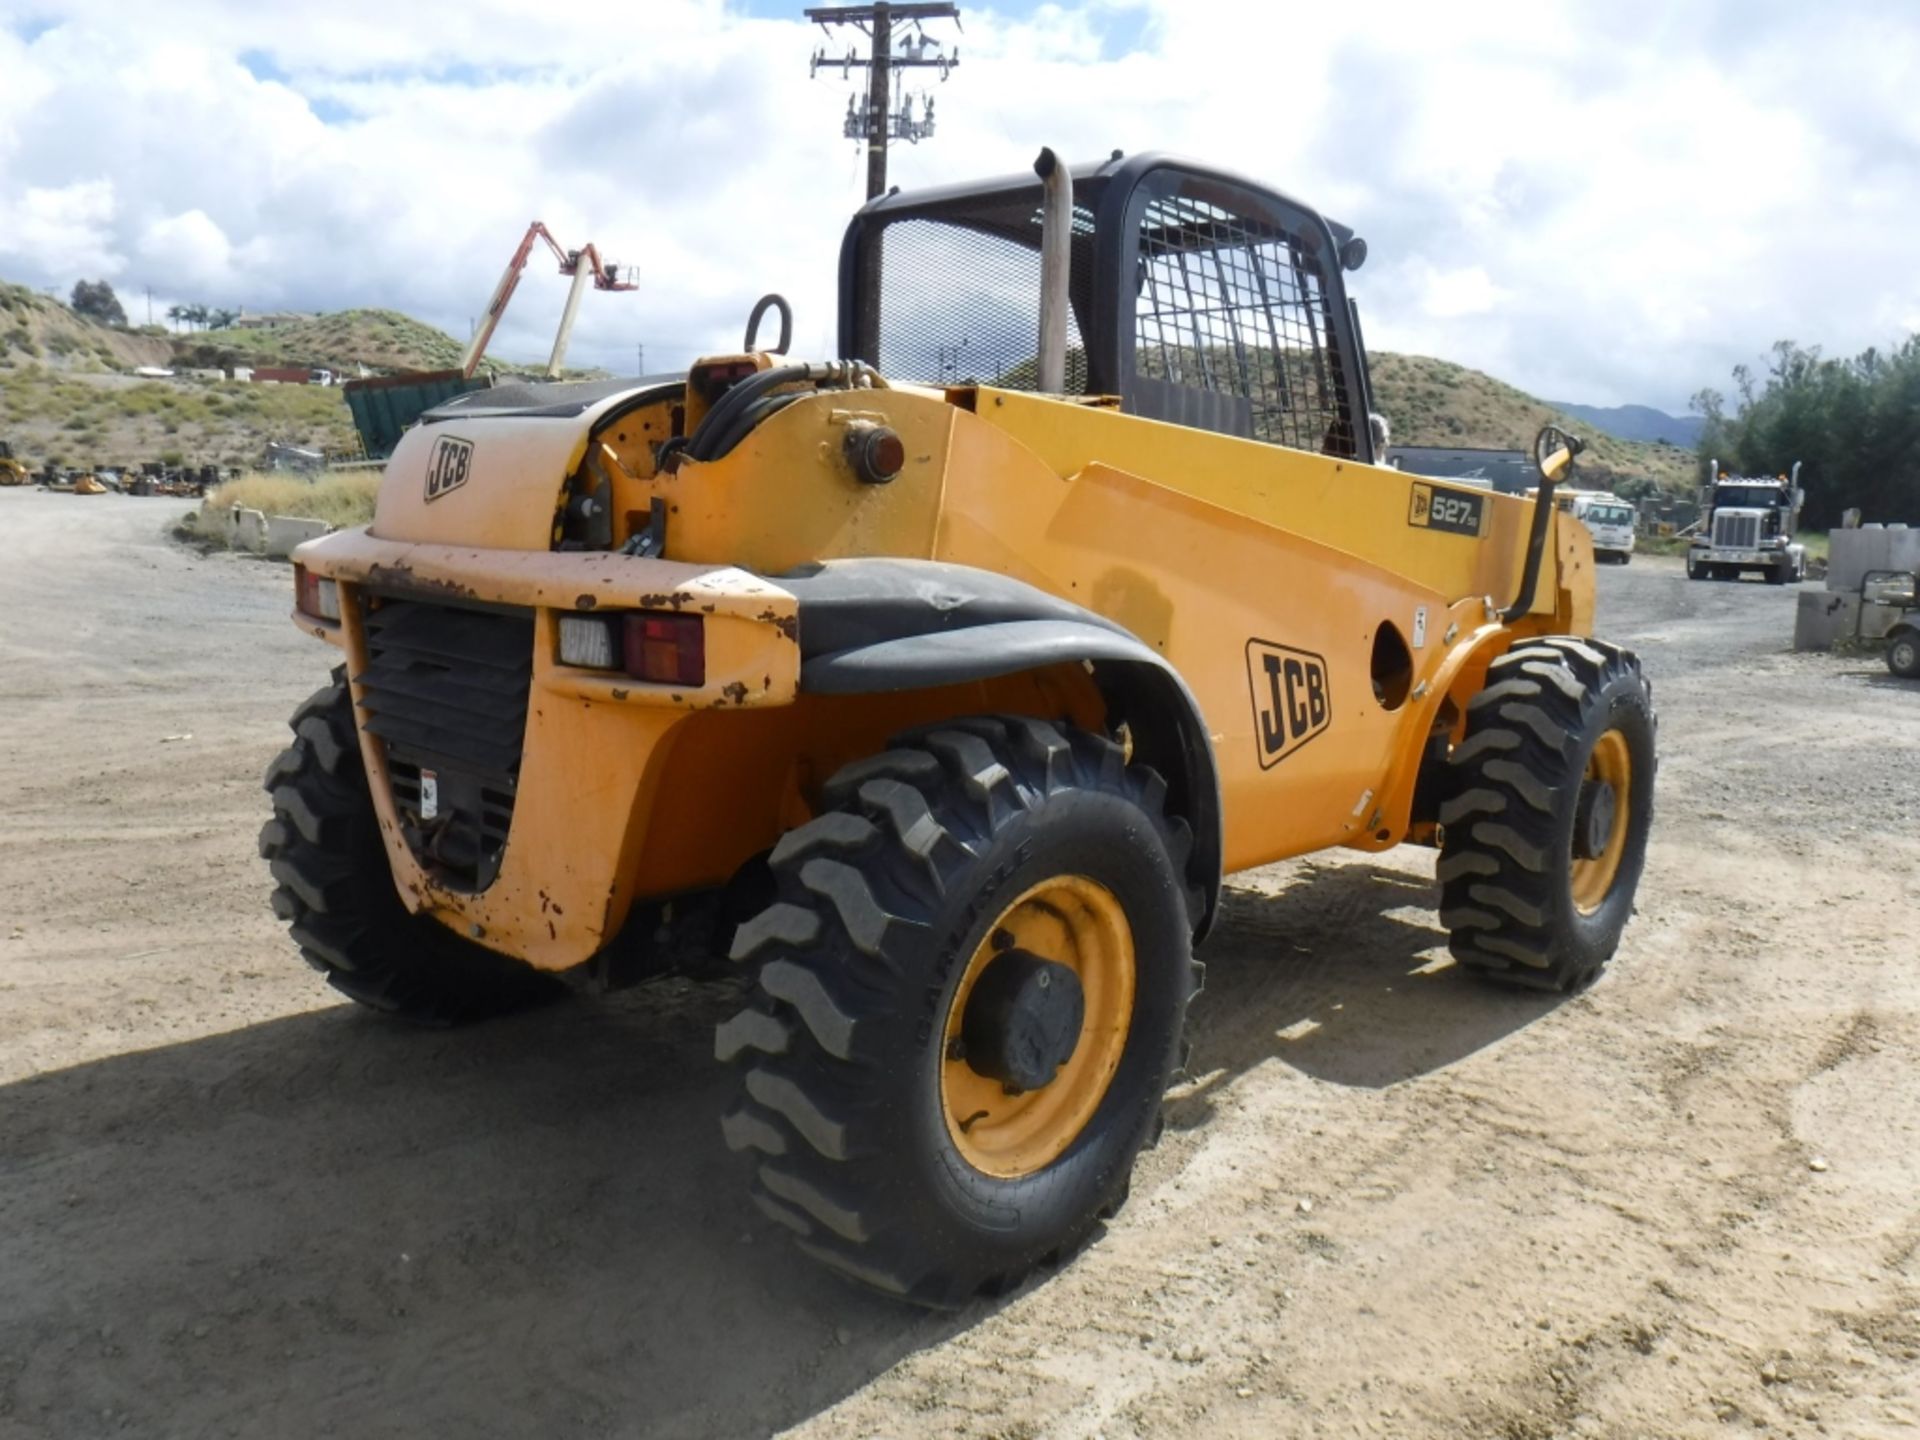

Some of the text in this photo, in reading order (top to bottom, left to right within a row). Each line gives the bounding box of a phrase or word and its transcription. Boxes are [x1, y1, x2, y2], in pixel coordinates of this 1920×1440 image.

[428, 441, 469, 496] JCB
[1432, 496, 1472, 525] 527
[1261, 652, 1326, 755] JCB
